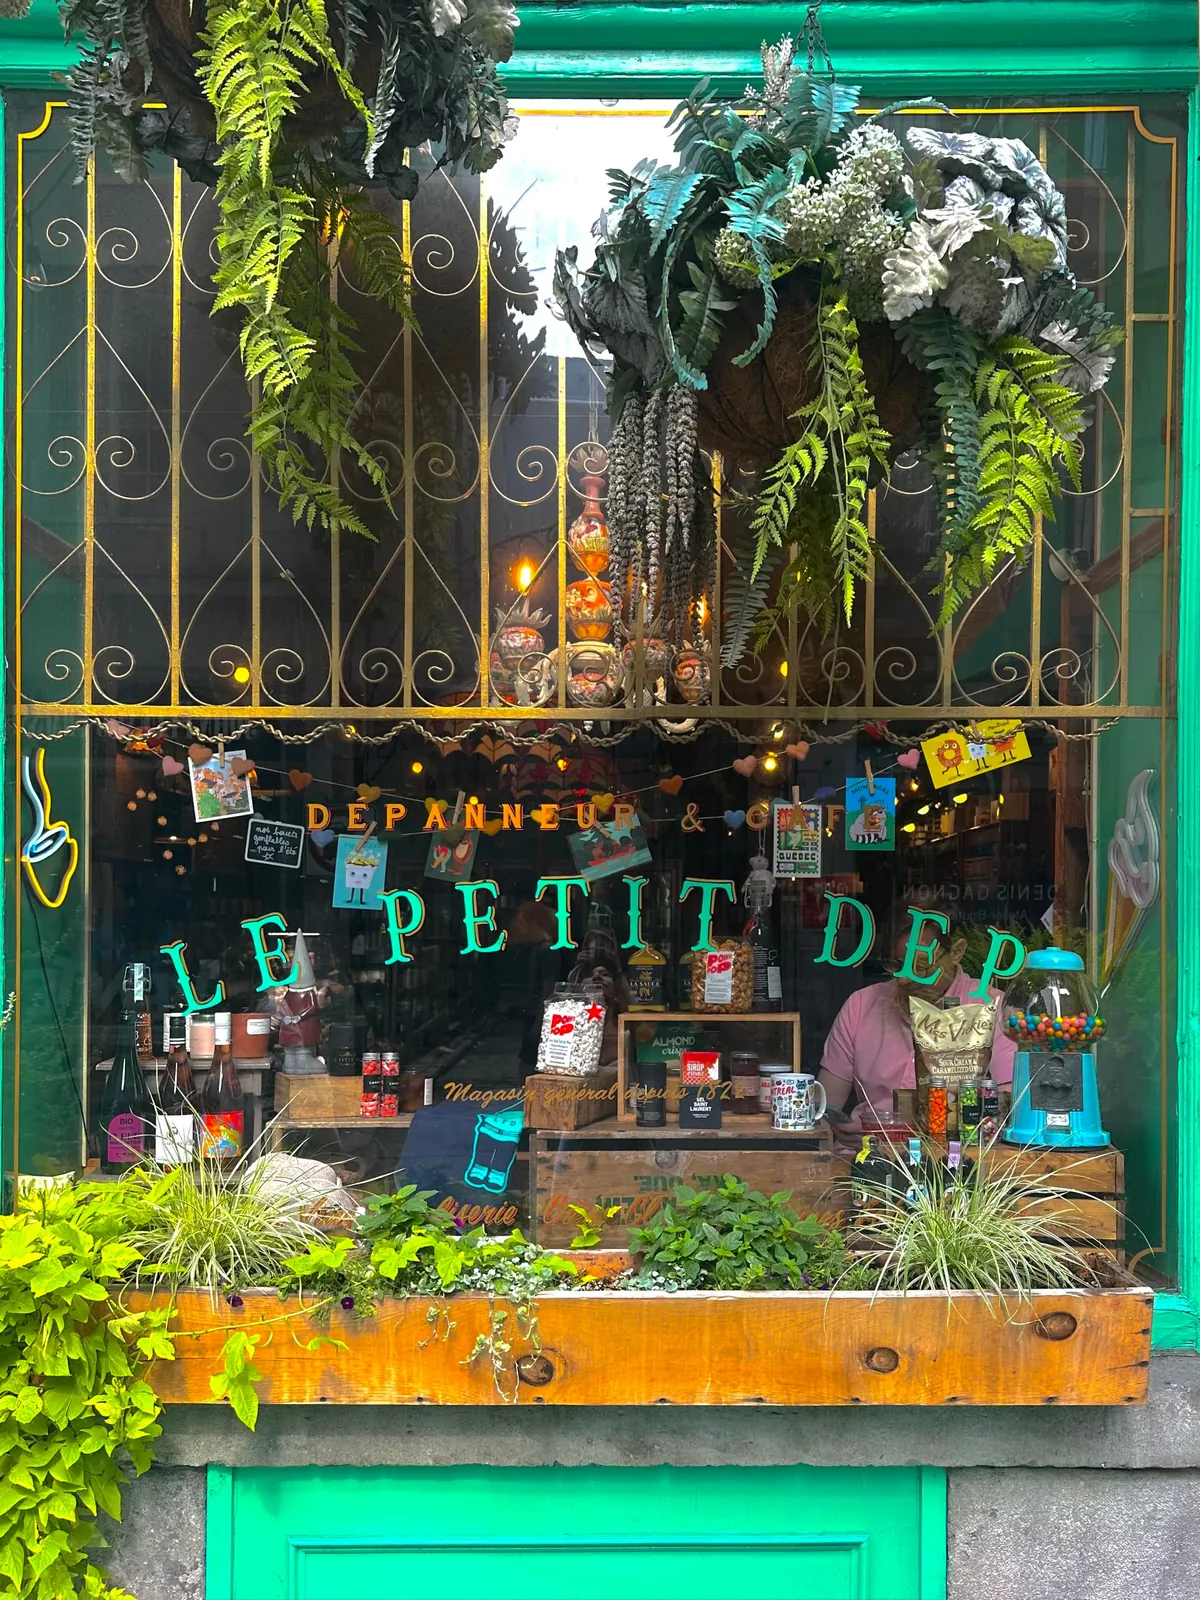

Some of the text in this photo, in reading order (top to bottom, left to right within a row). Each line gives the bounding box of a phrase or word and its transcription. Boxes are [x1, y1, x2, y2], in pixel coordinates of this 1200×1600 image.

[851, 783, 889, 796] MONRÉAL
[306, 797, 637, 831] DÉPANNEUR
[680, 802, 706, 833] &
[160, 911, 302, 1017] LE
[377, 874, 737, 966] PETIT
[813, 890, 1028, 1004] DEP
[652, 1036, 696, 1047] ALMOND
[686, 1063, 705, 1071] SIROP
[444, 1081, 536, 1110] Magasin
[543, 1079, 617, 1109] général
[623, 1081, 690, 1105] depuis
